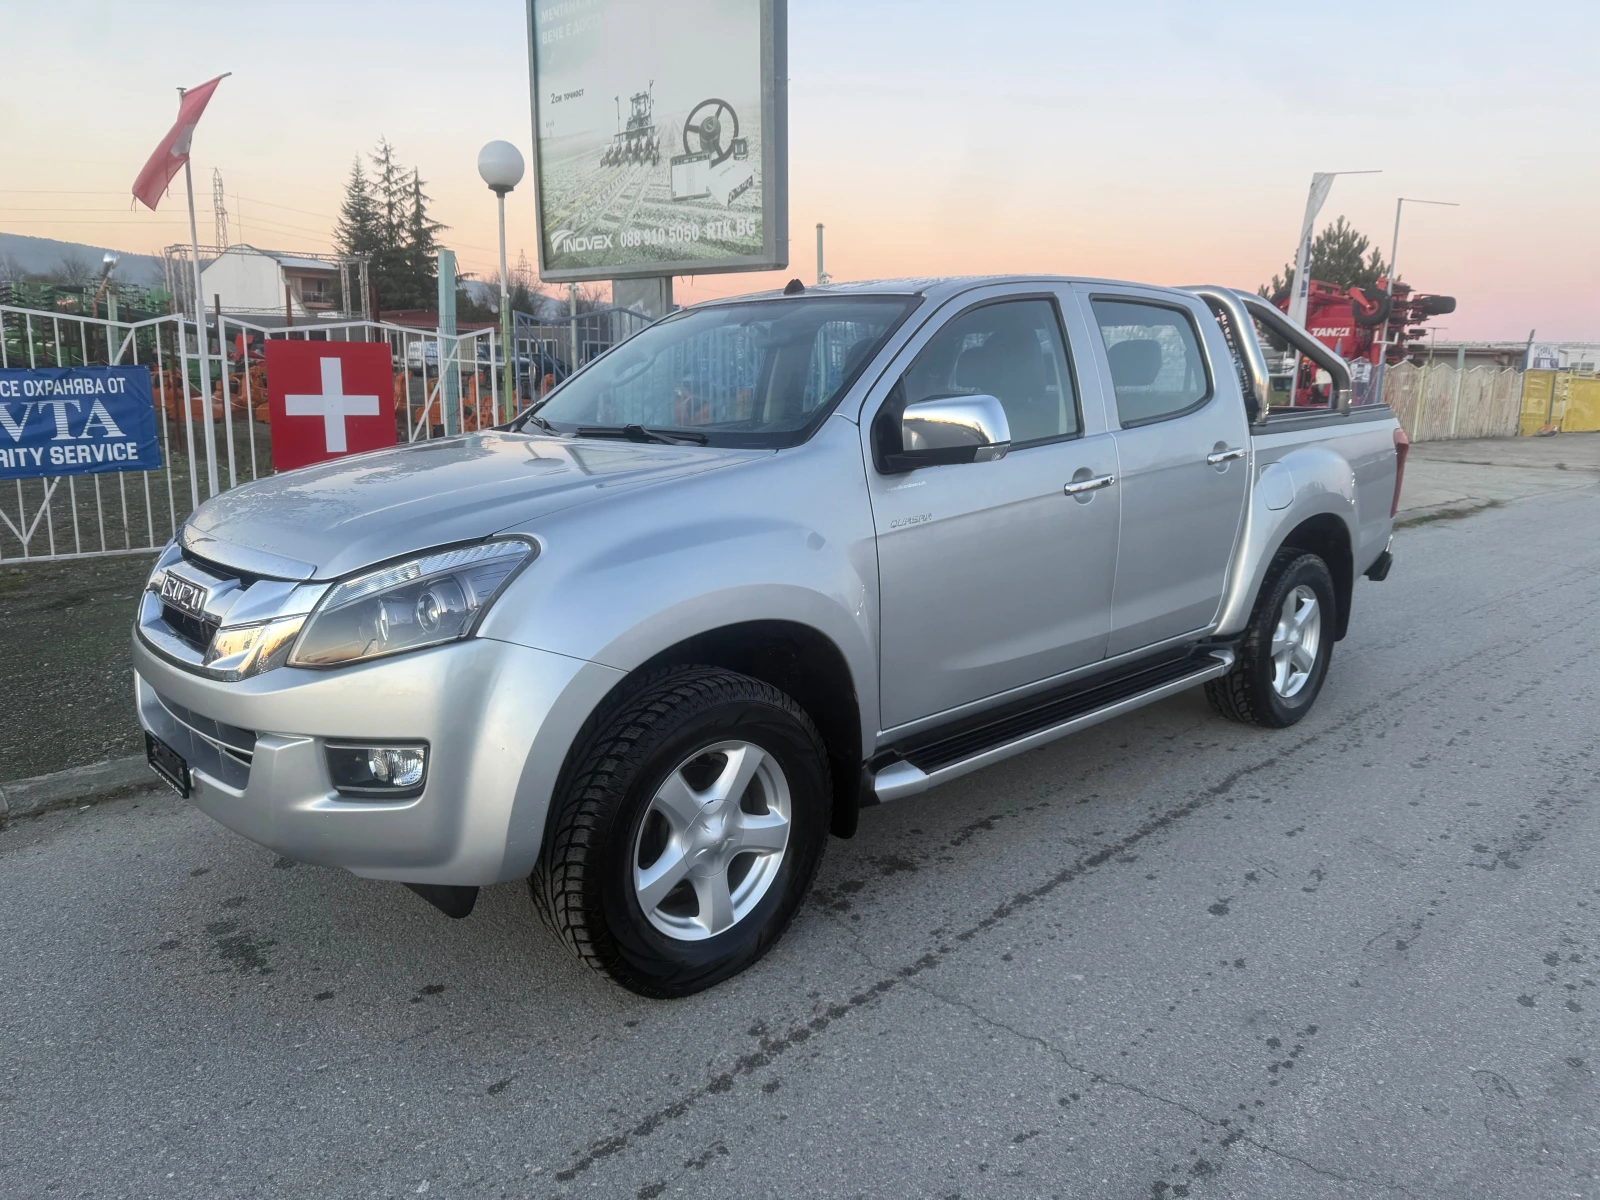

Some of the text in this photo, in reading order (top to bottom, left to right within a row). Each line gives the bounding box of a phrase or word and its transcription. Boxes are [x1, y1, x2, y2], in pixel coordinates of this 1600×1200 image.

[541, 25, 564, 45] ВЕЧЕ
[563, 217, 756, 253] INOVEX 088 910 5050 RTK.BG
[0, 377, 126, 397] СЕ ОХРАНЯВА ОТ
[50, 442, 139, 465] SERVICE
[161, 574, 206, 613] ISUZU
